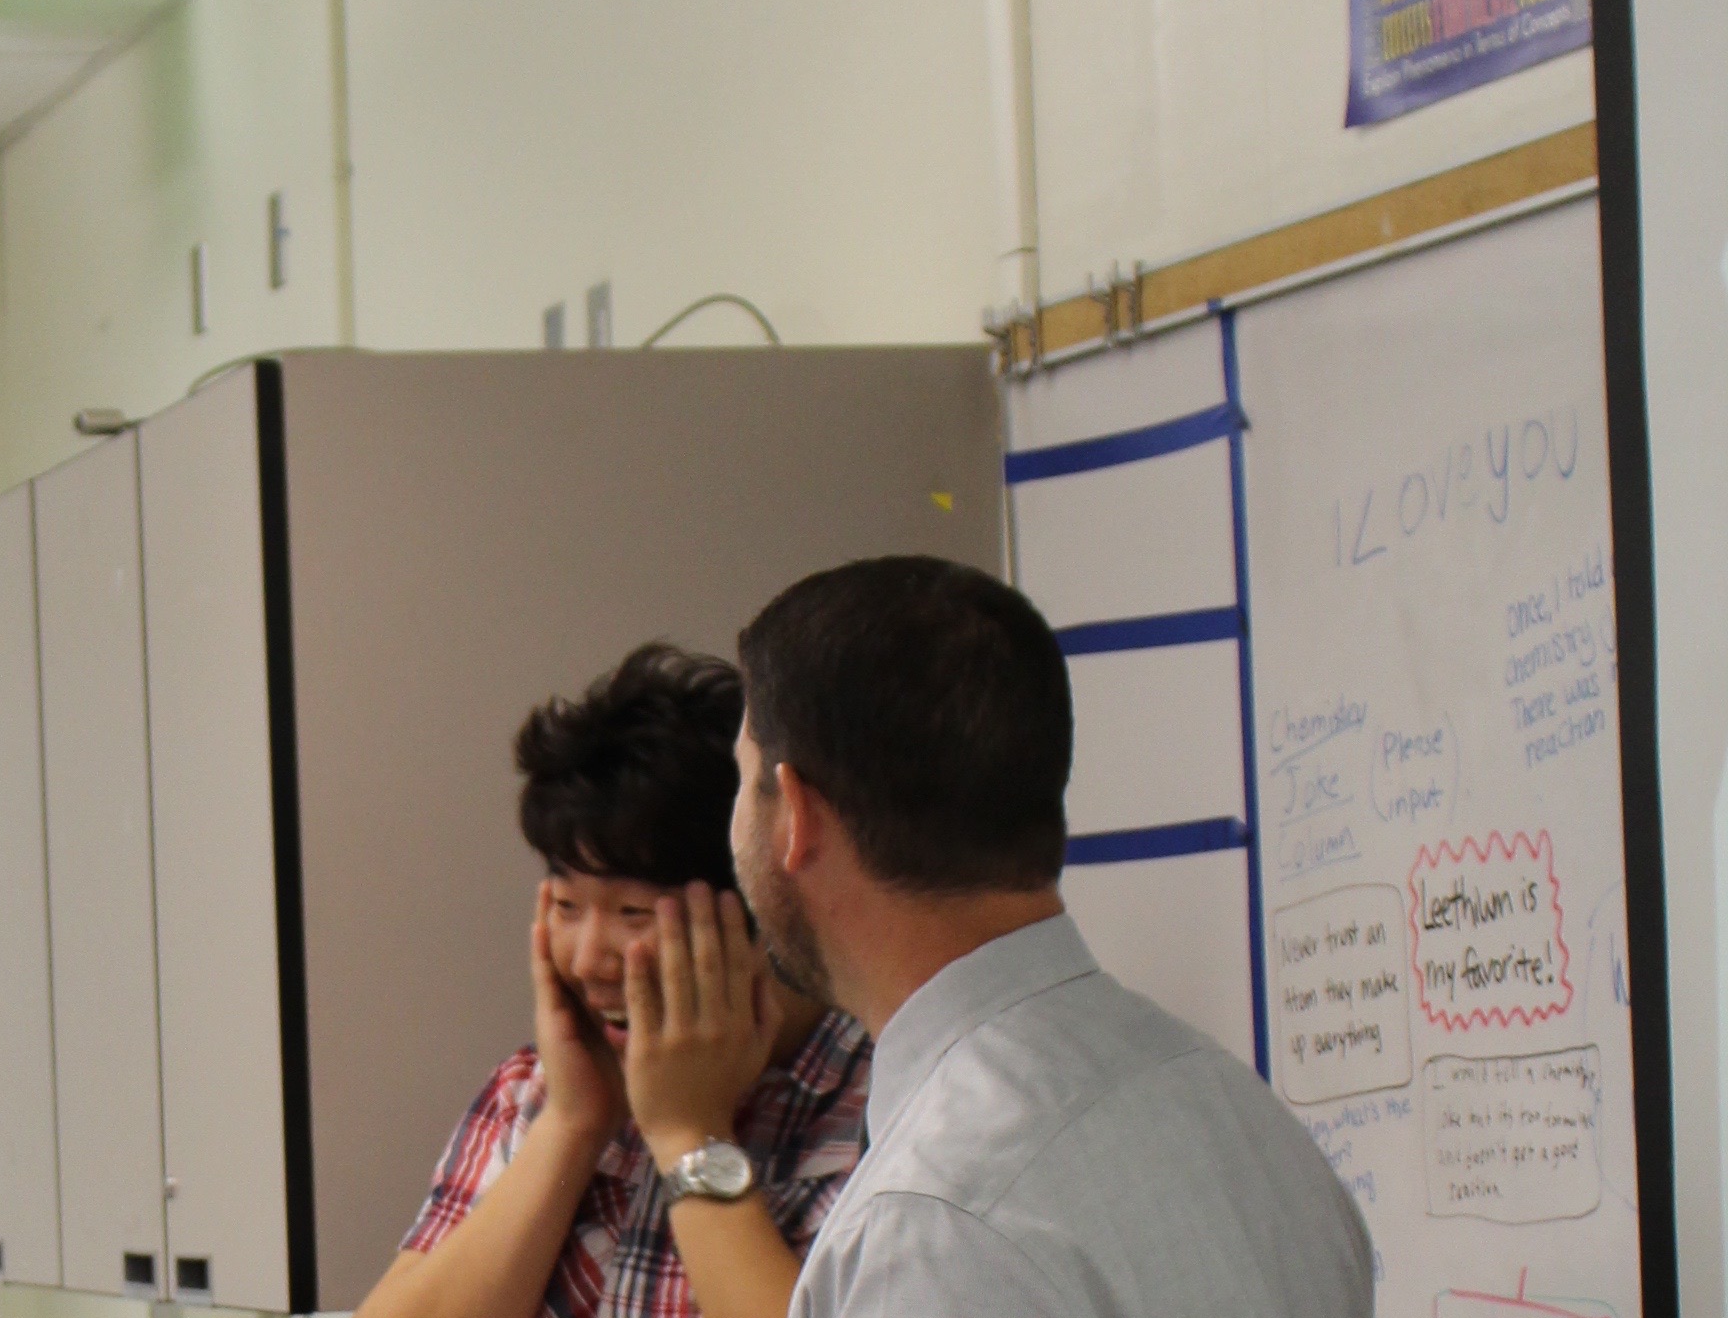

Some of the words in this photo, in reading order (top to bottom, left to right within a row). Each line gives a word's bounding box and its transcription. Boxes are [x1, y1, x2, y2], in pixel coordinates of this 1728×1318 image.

[1522, 876, 1539, 915] is
[1425, 958, 1457, 1003] my
[1460, 941, 1556, 992] favorite!
